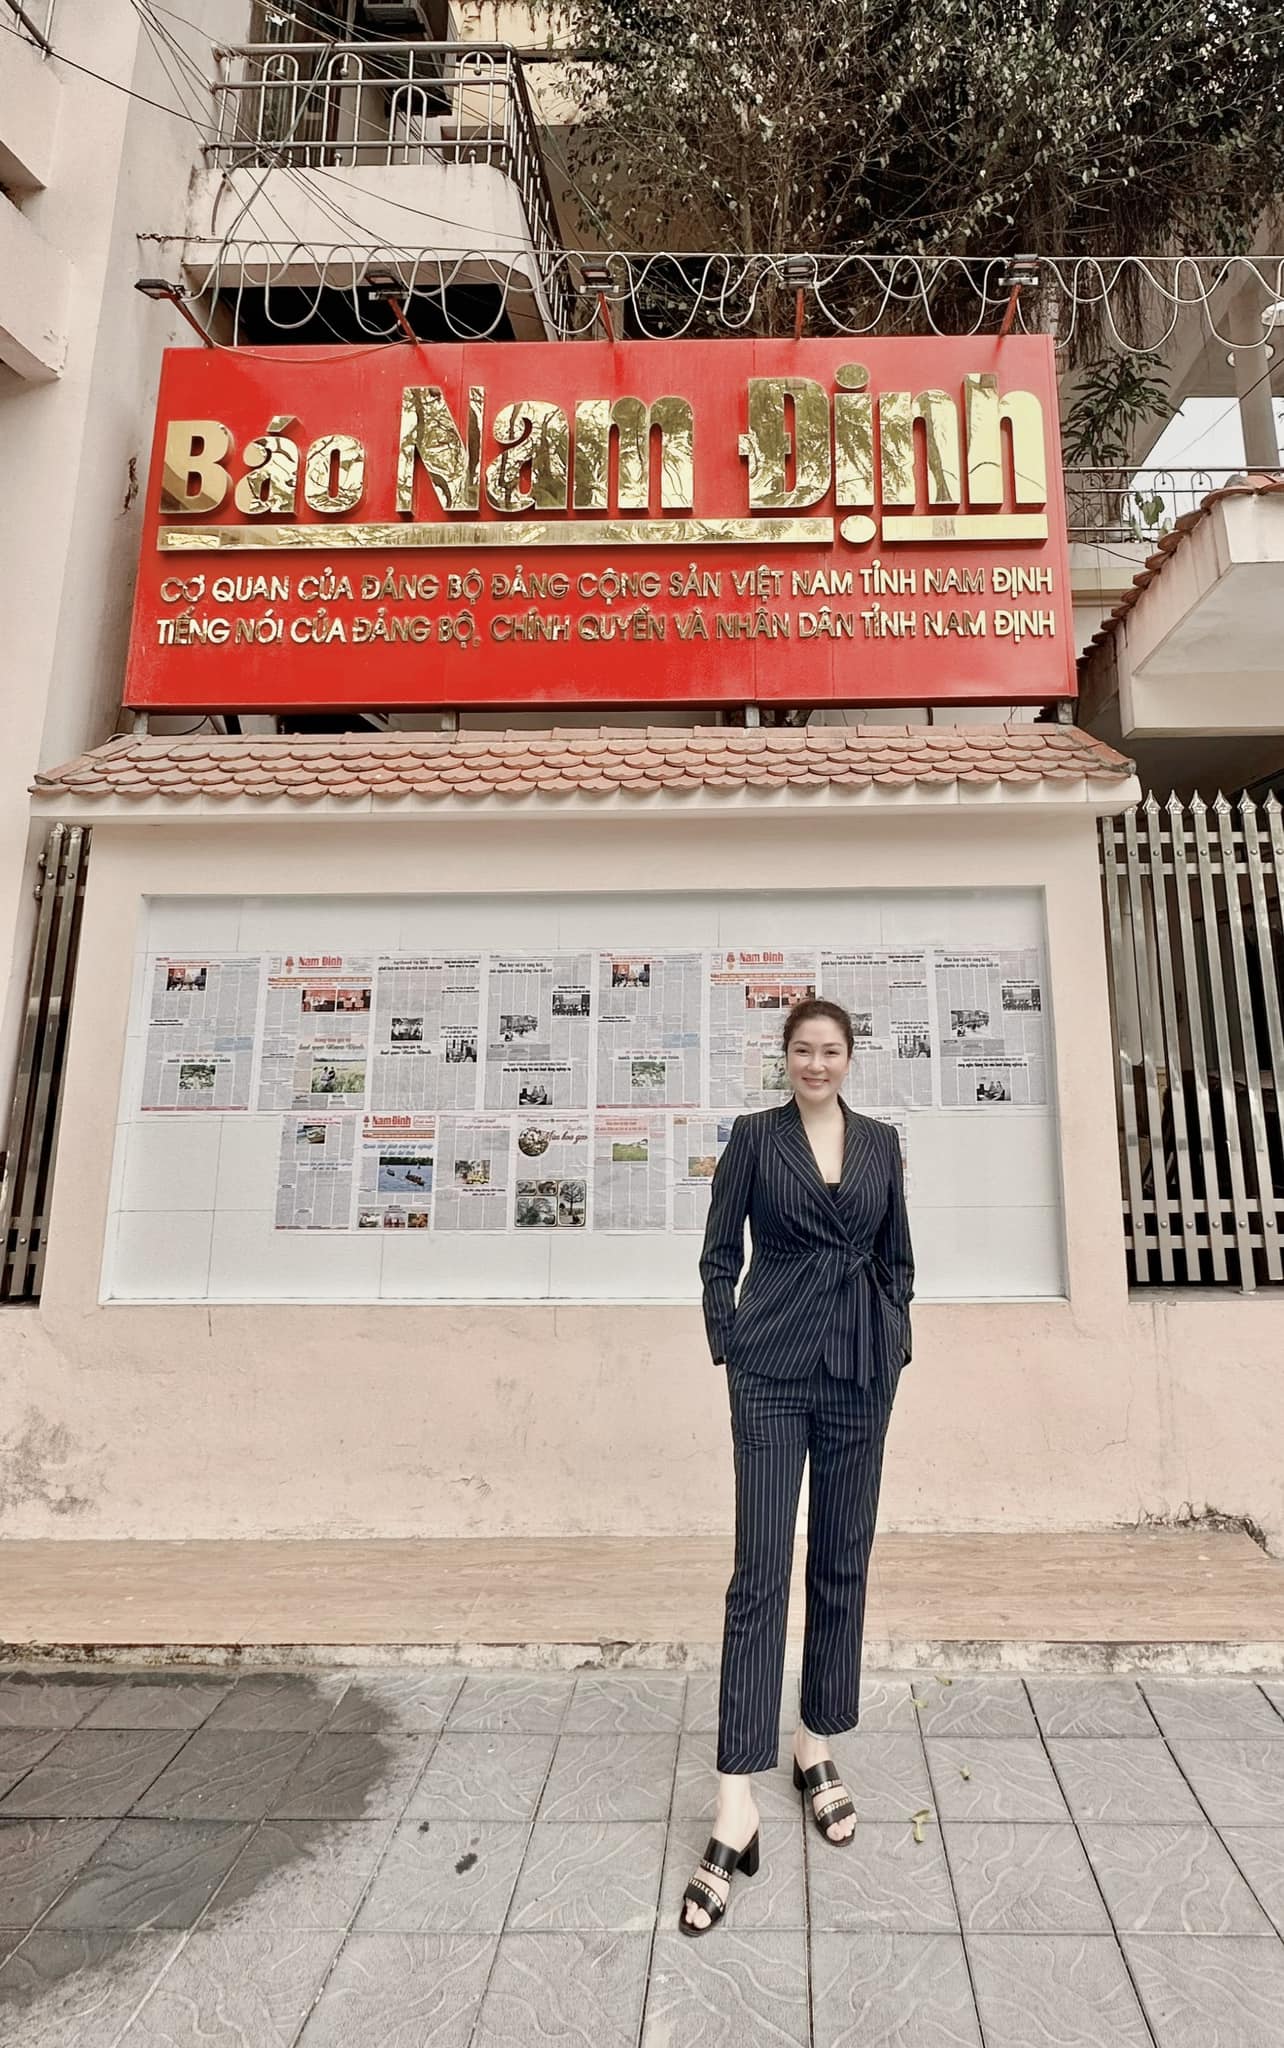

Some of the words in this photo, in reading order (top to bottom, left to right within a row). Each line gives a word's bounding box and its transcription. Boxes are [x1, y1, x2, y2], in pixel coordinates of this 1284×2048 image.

[158, 414, 369, 516] Báo
[395, 384, 694, 516] Nam
[738, 362, 1048, 544] Định
[160, 574, 206, 602] CƠ
[211, 575, 290, 602] QUAN
[297, 566, 354, 600] CỦA
[360, 566, 440, 601] ĐẢNG
[447, 568, 485, 606] BỘ
[491, 564, 570, 599] ĐẢNG
[577, 567, 662, 606] CỘNG
[669, 562, 721, 597] SẢN
[731, 564, 785, 603] VIỆT
[791, 569, 854, 597] NAM
[860, 559, 918, 595] TỈNH
[924, 567, 985, 594] NAM
[992, 566, 1054, 599] ĐỊNH
[157, 605, 232, 645] TIẾNG
[235, 608, 285, 644] NÓI
[290, 607, 348, 644] CỦA
[352, 607, 432, 644] ĐẢNG
[490, 606, 570, 641] CHÍNH
[673, 607, 709, 640] VÀ
[716, 606, 791, 639] NHÂN
[799, 605, 855, 638] DÂN
[860, 602, 917, 637] TỈNH
[923, 610, 987, 637] NAM
[994, 610, 1056, 643] ĐỊNH
